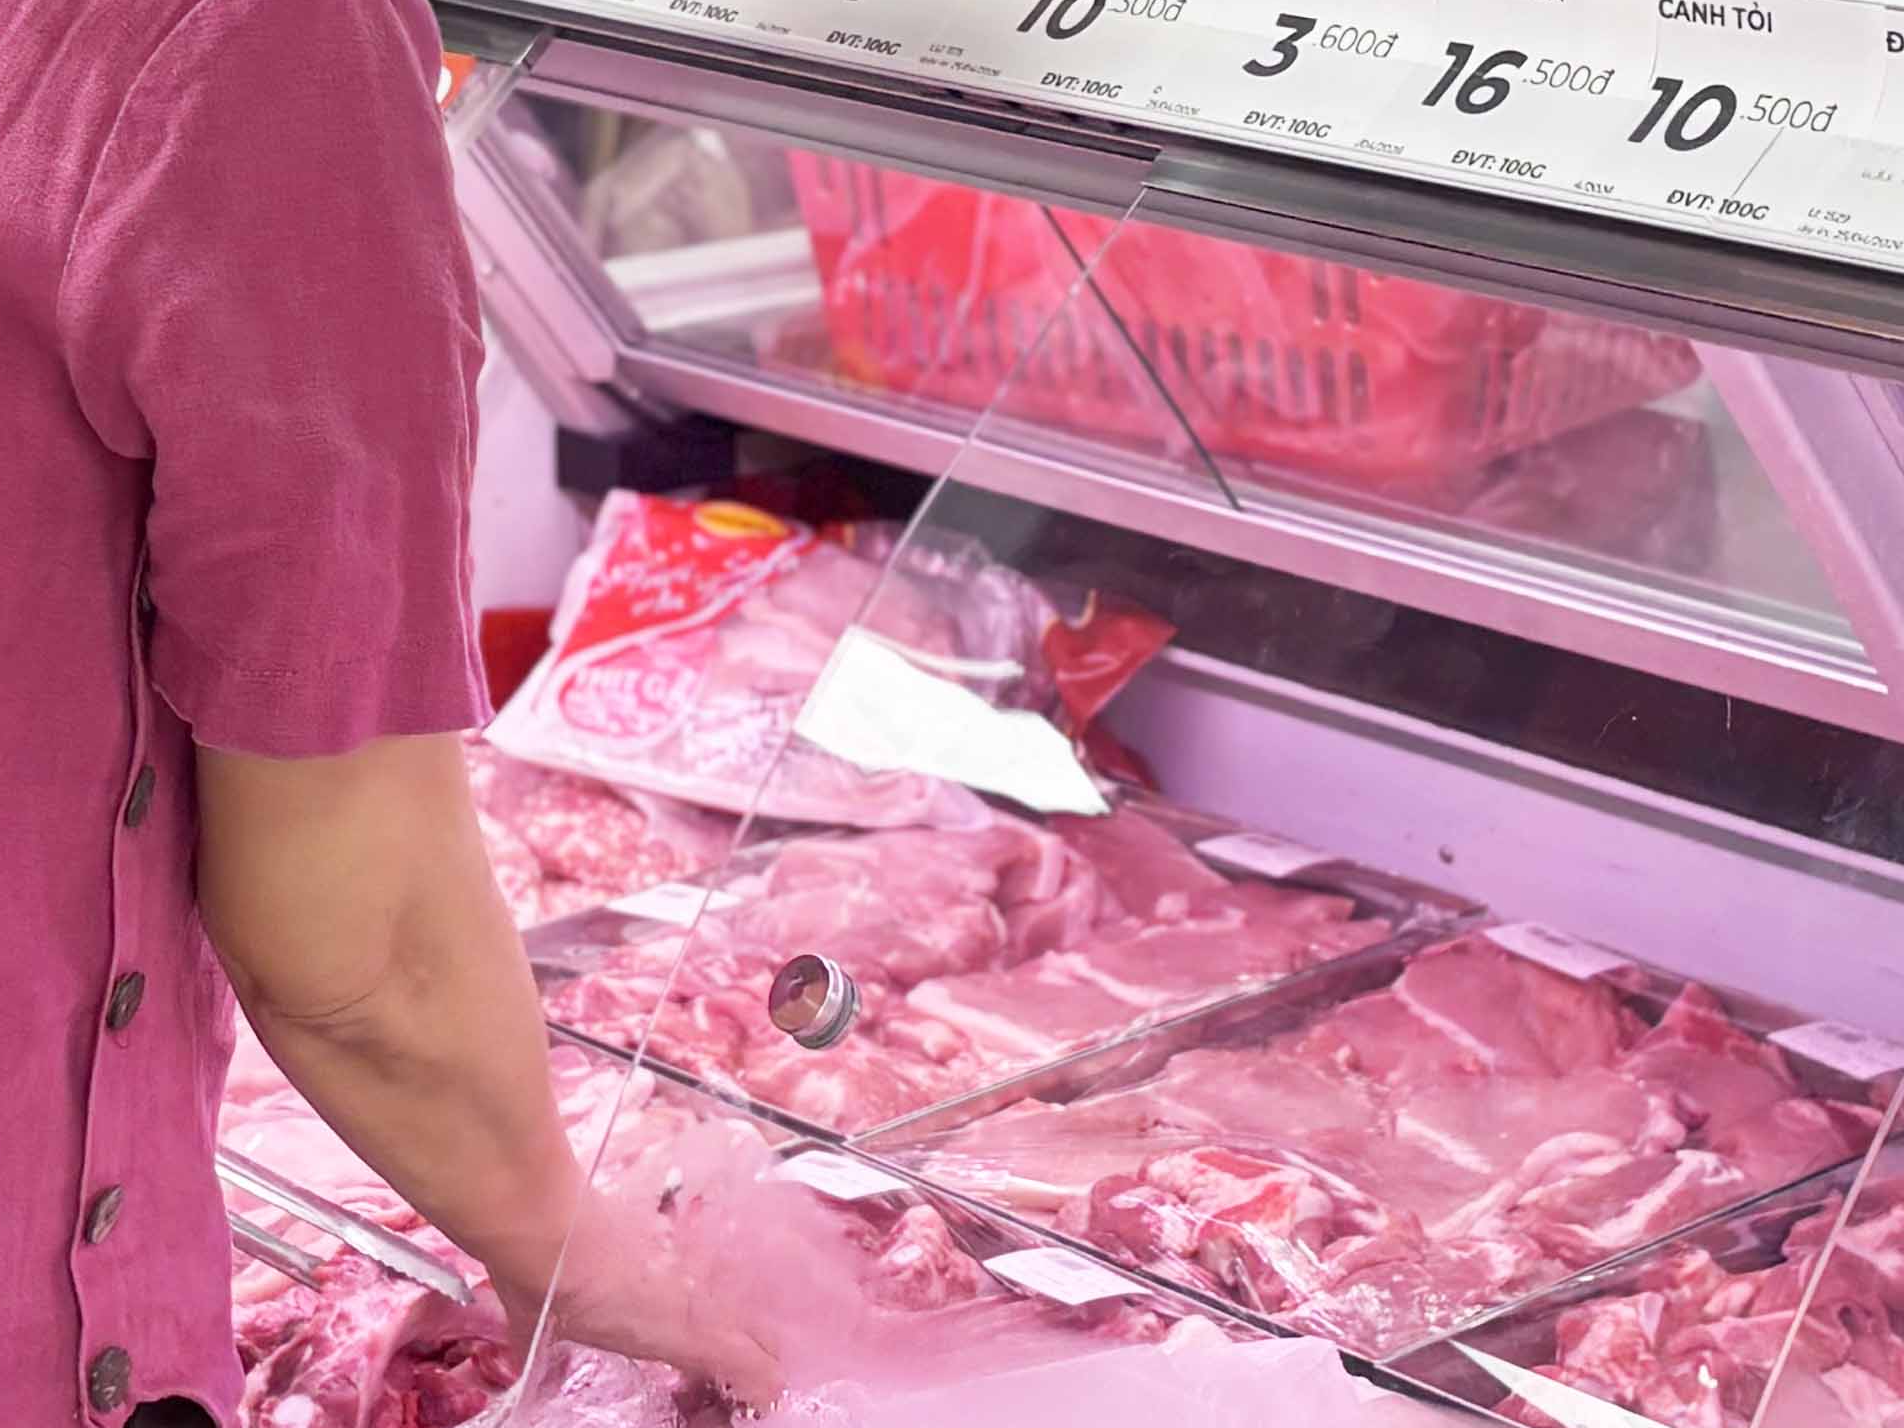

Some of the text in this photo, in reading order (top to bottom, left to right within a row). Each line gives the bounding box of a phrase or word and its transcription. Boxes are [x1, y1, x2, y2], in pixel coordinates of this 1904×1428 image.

[703, 4, 739, 24] 100G
[862, 36, 902, 56] 100G
[1081, 79, 1123, 99] 100G
[1243, 110, 1333, 140] ĐVT: 100G
[1451, 148, 1547, 180] ĐVT: 100G
[1666, 189, 1770, 222] ĐVT: 100G
